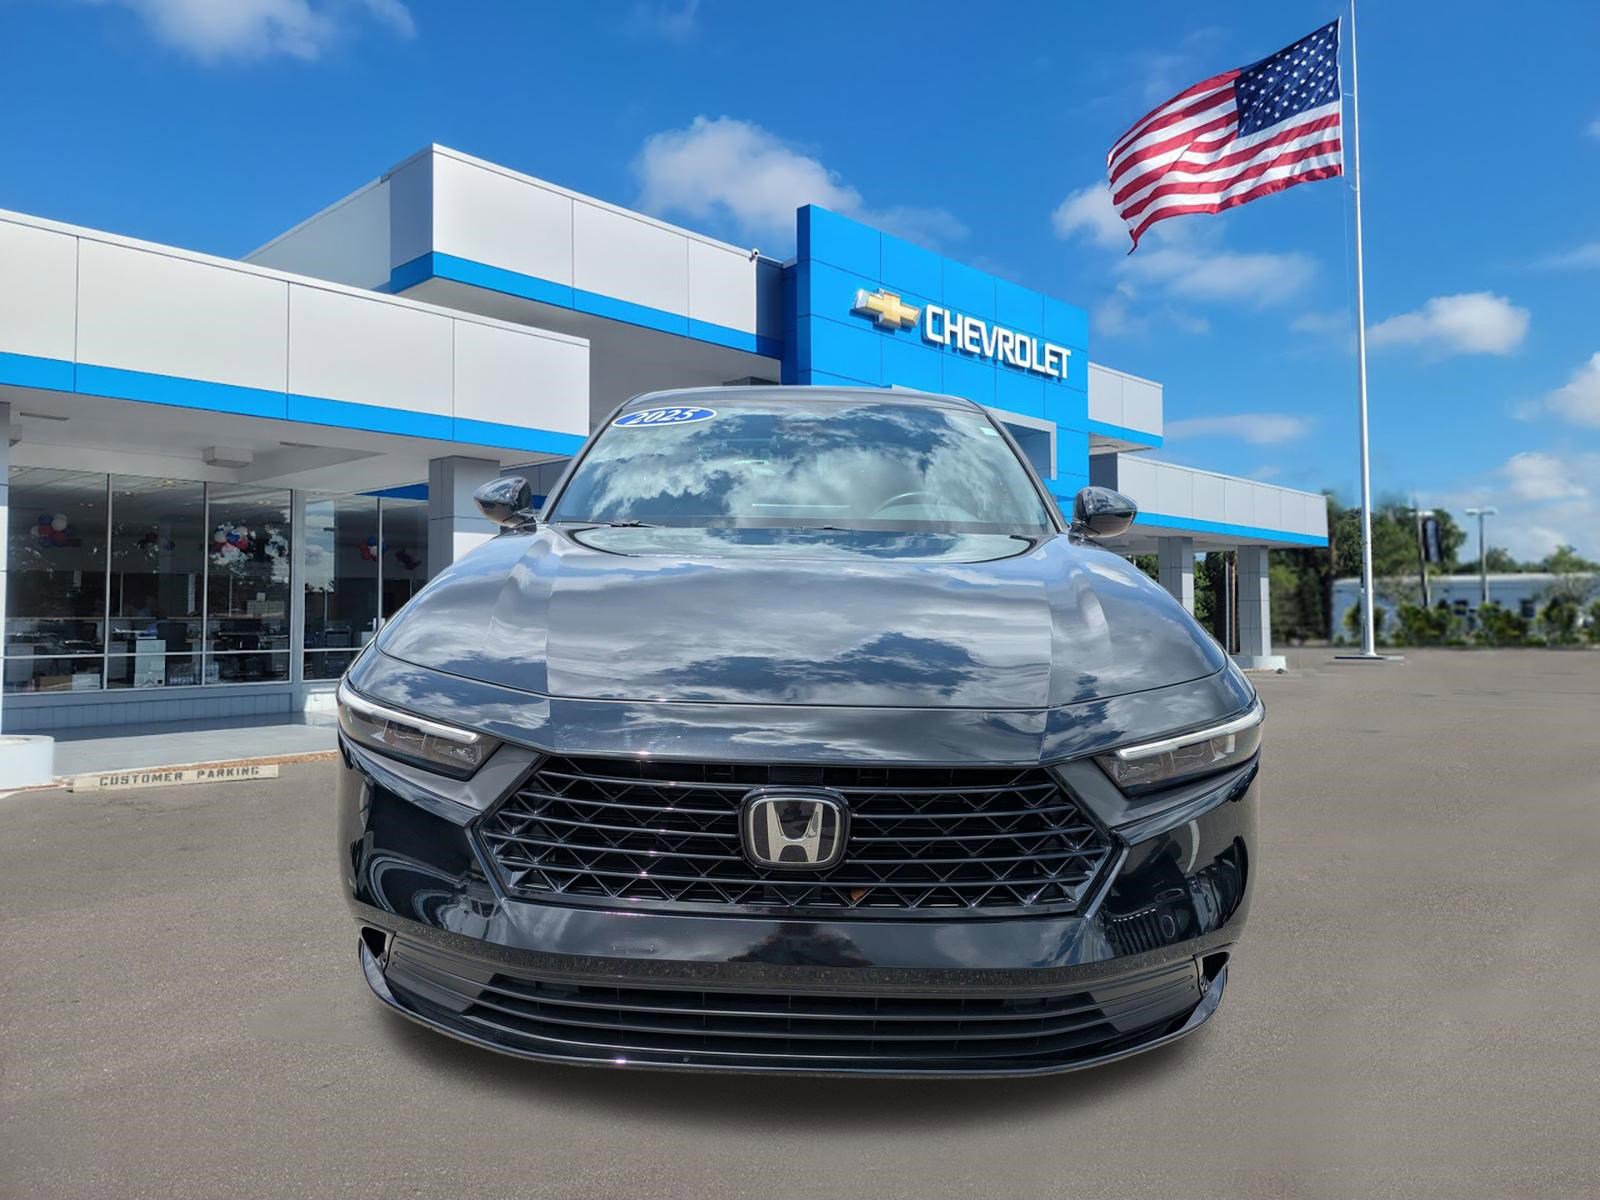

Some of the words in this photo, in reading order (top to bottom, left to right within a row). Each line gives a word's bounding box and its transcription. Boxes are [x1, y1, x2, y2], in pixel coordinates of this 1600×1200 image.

[924, 303, 1072, 379] CHEVROLET
[625, 407, 701, 426] 2025
[99, 771, 184, 787] CUSTOMER
[196, 765, 261, 779] PARKING
